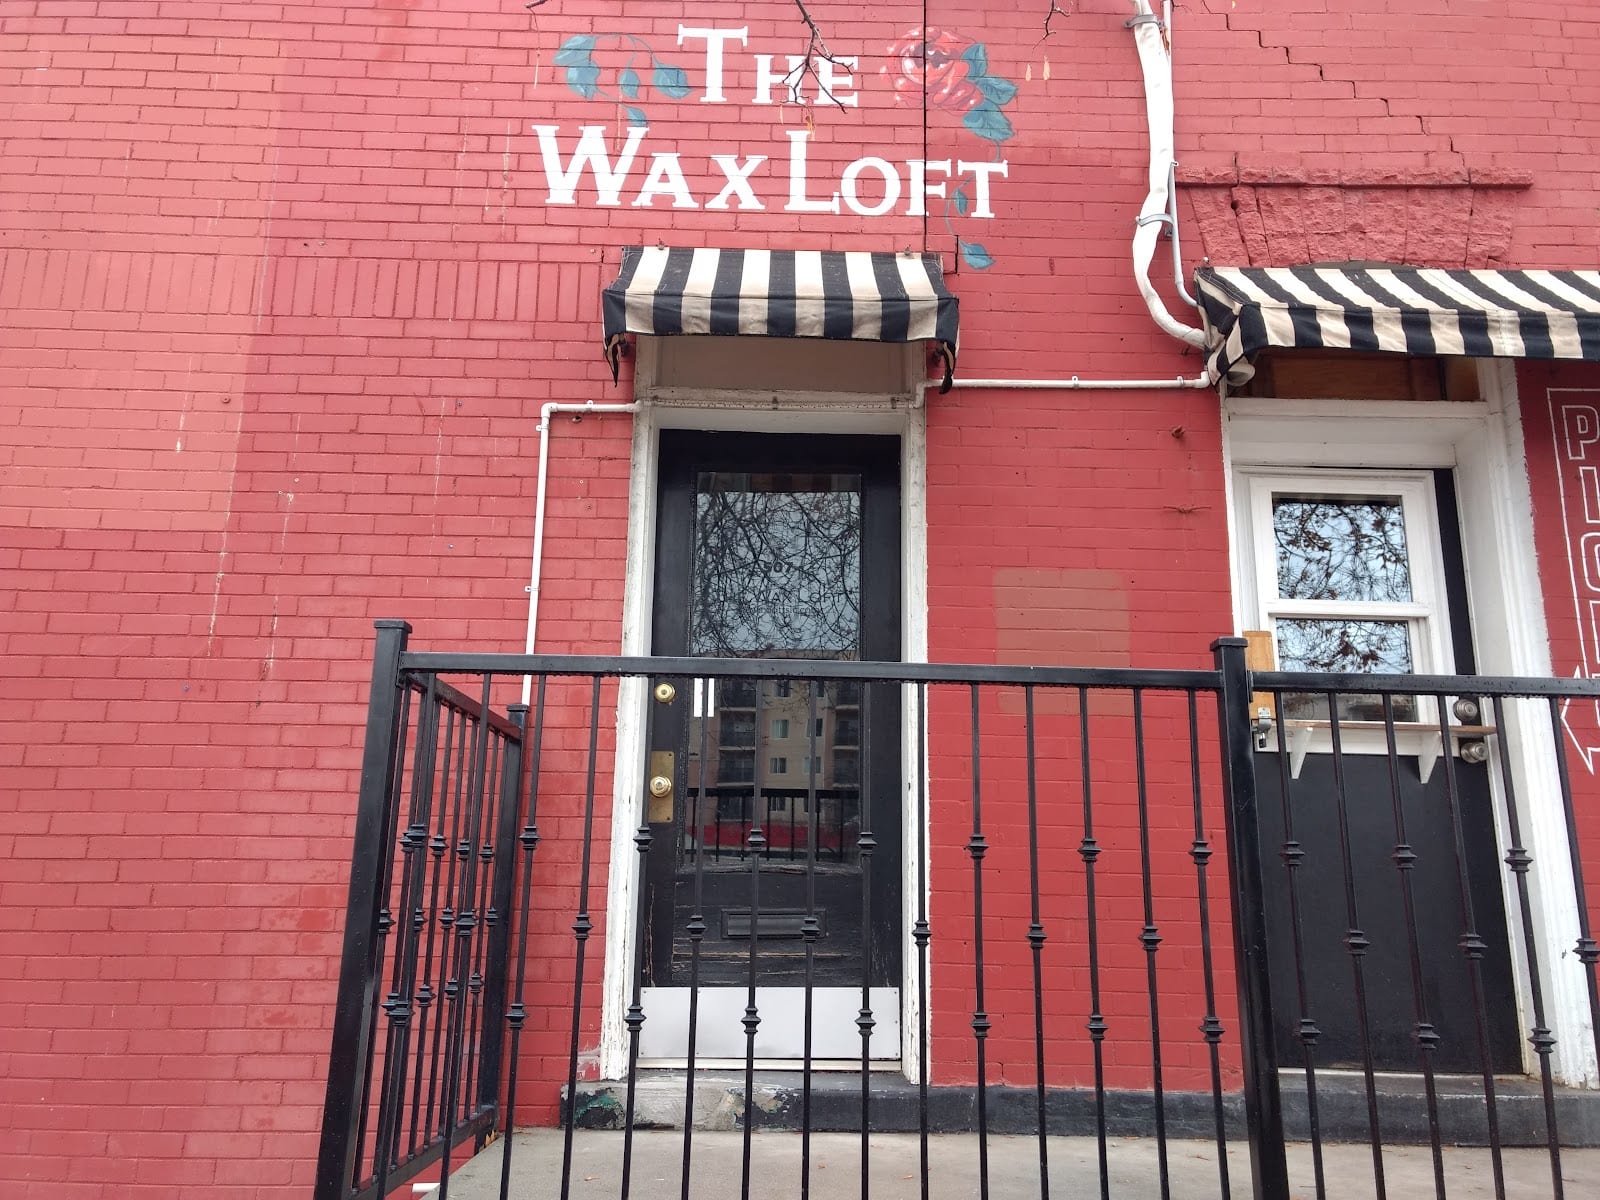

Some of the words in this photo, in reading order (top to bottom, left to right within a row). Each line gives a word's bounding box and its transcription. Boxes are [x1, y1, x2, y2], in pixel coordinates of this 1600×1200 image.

[677, 24, 859, 108] THE
[531, 124, 768, 210] WAX
[783, 129, 1009, 219] LOFT
